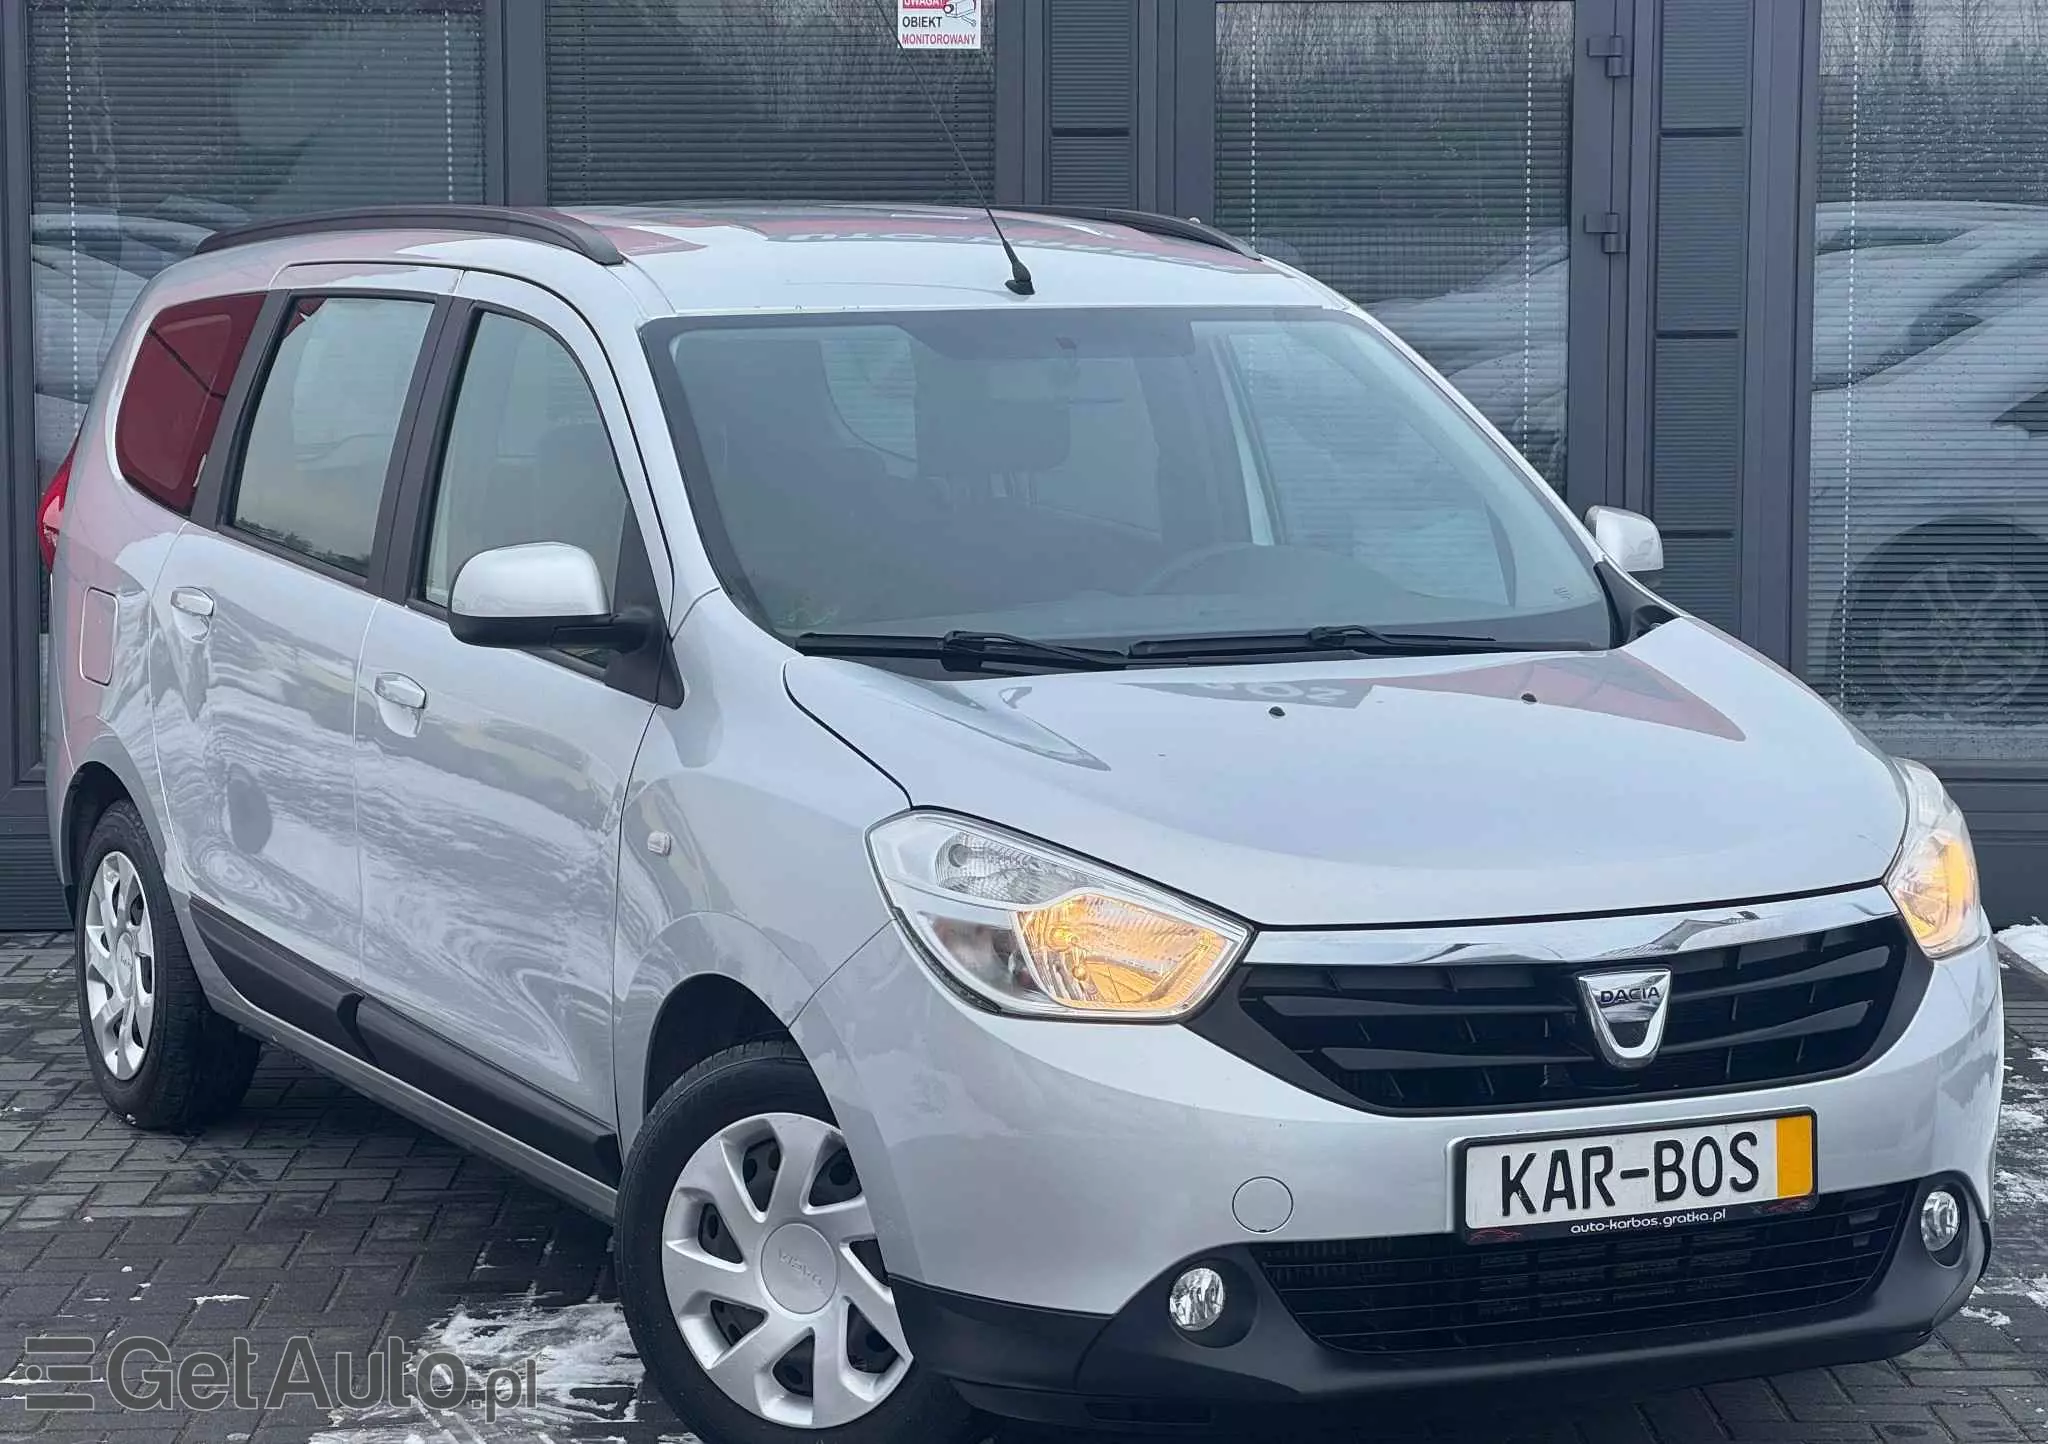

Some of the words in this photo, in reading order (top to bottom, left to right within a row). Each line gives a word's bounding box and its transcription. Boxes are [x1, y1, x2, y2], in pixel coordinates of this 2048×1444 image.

[902, 16, 943, 28] OBIEKT
[902, 33, 976, 45] MONITOROWANY
[1600, 986, 1660, 1003] DACIA
[1501, 1131, 1759, 1217] KAR-BOS
[1570, 1208, 1726, 1234] auto-karbos.gratka.pl
